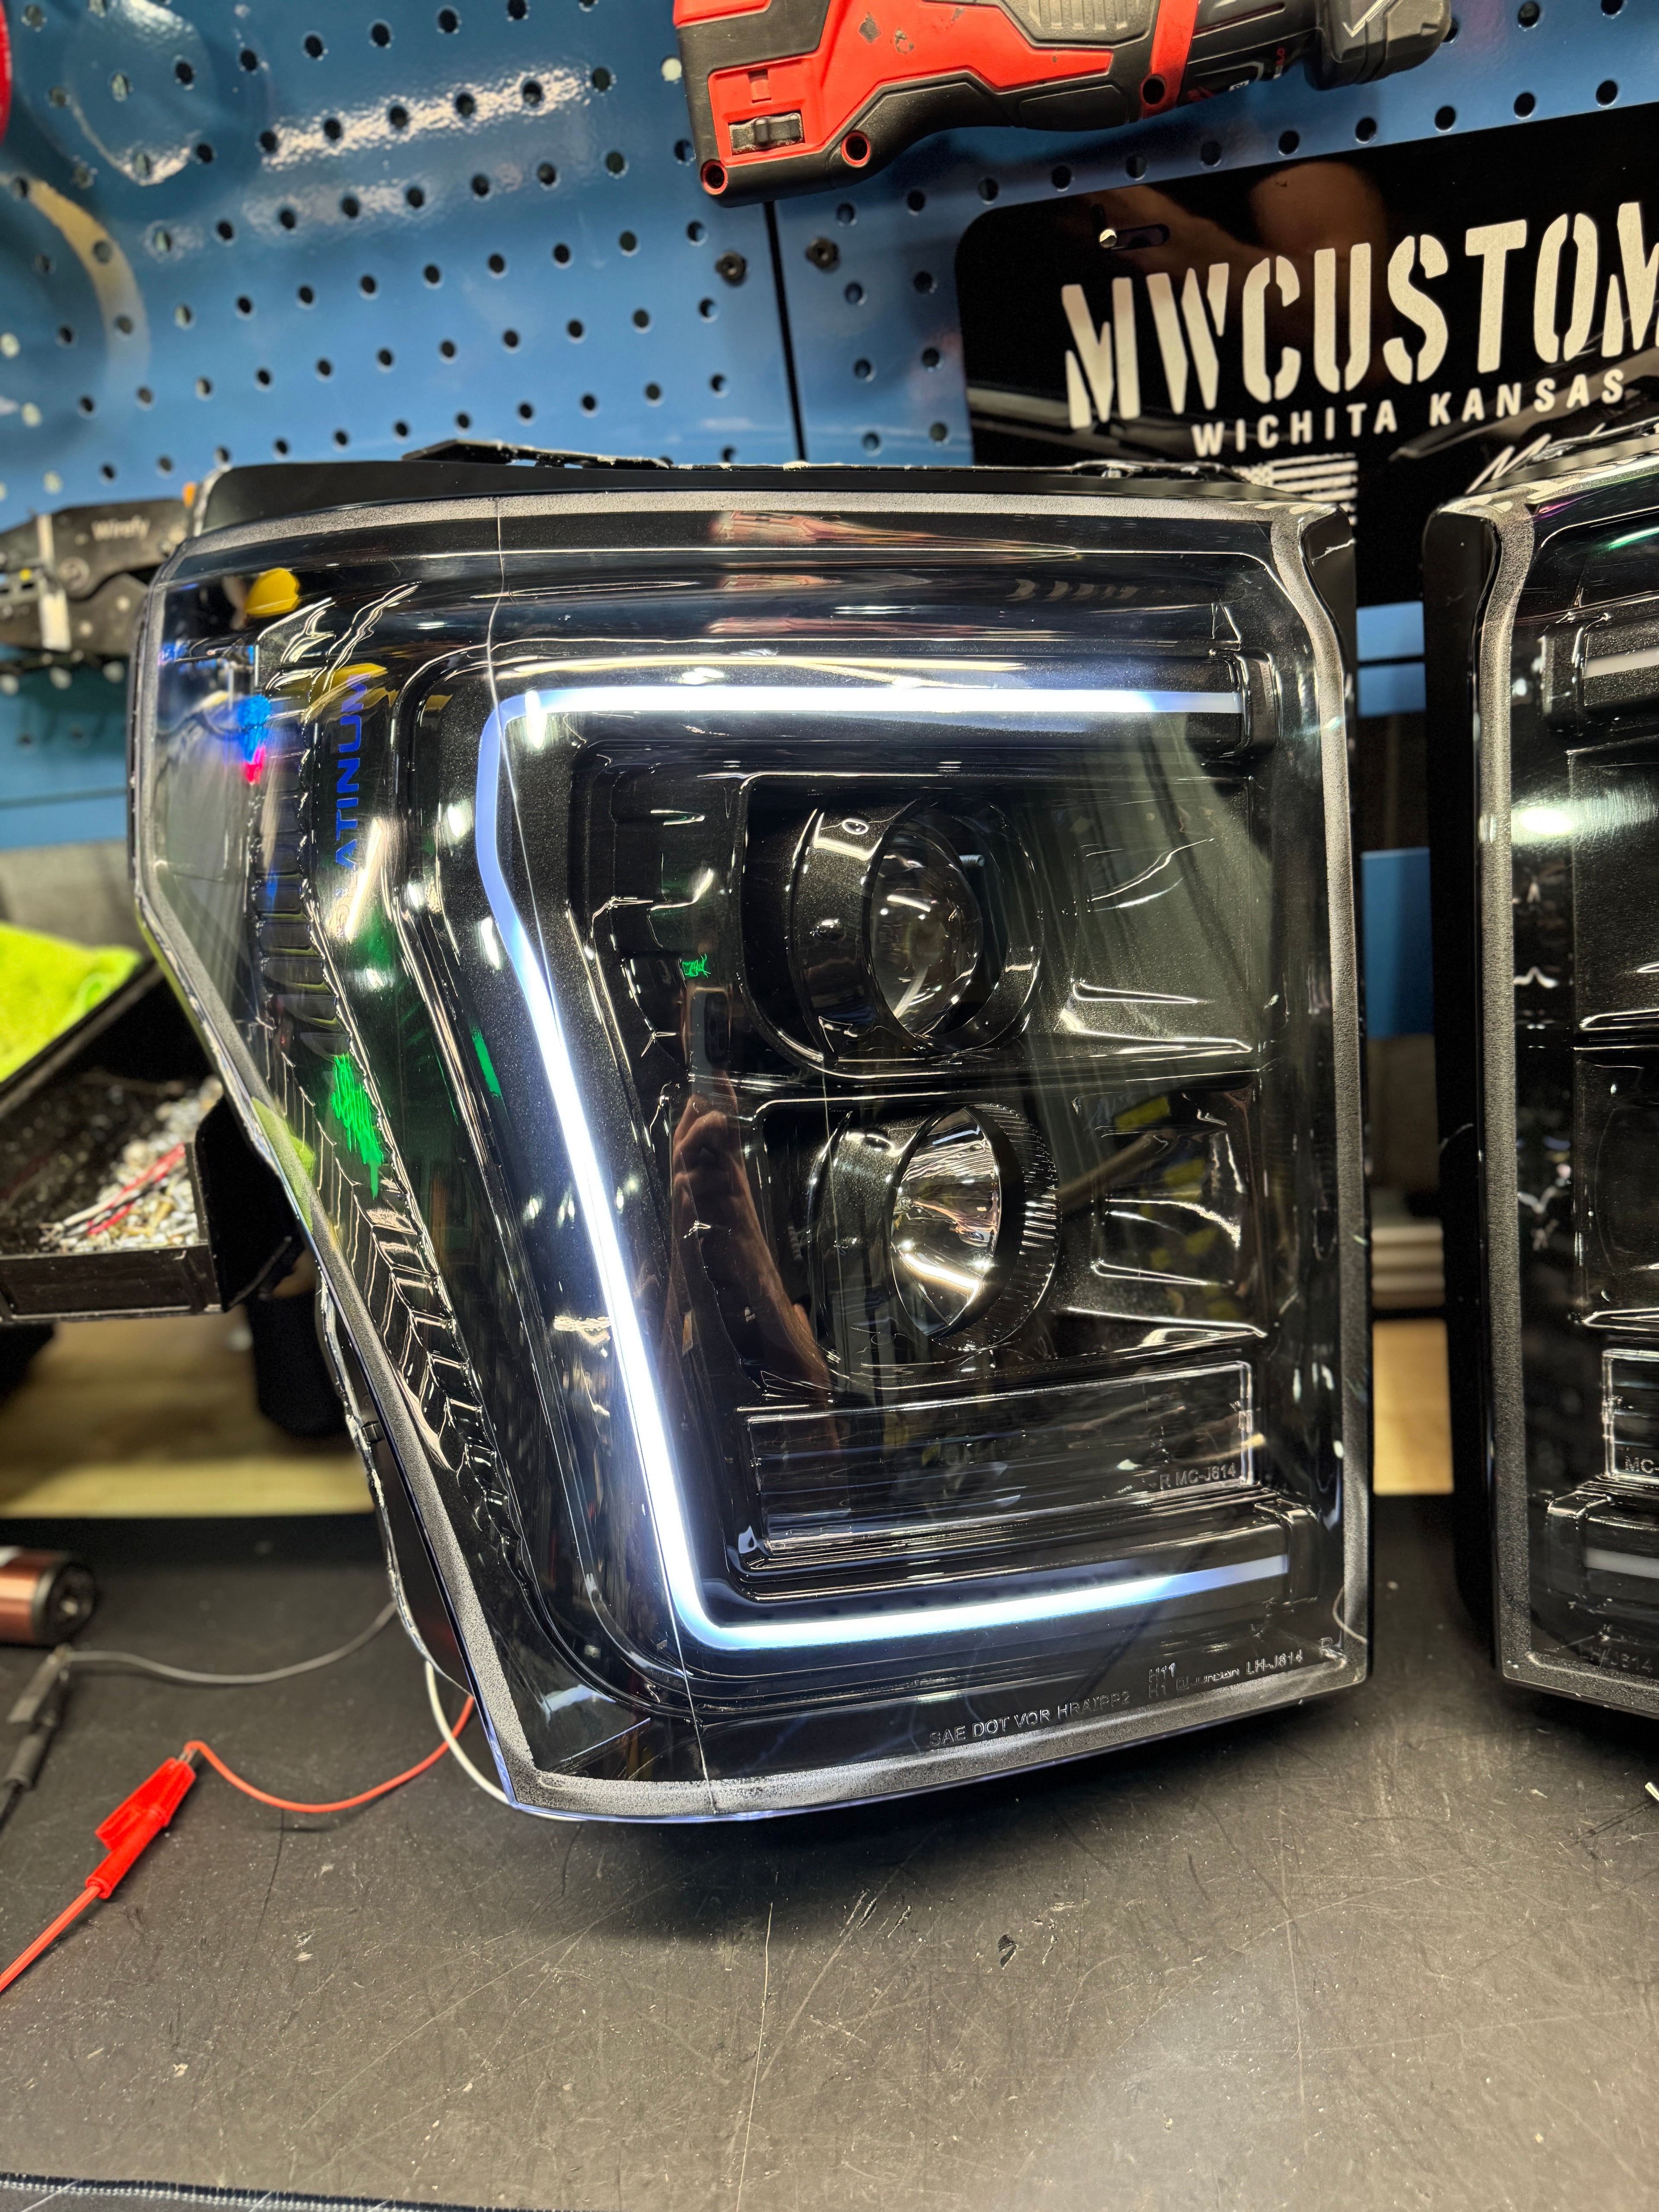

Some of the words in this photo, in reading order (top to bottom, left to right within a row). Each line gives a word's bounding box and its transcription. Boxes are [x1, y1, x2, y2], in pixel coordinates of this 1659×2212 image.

[1191, 399, 1397, 457] WICHITA
[1428, 369, 1624, 425] KANSAS
[1160, 1474, 1171, 1490] R
[1176, 1462, 1236, 1486] MC-J614
[1149, 1662, 1176, 1683] H11
[1149, 1682, 1166, 1698] H1
[929, 1725, 966, 1746] SAE
[972, 1716, 1009, 1738] DOT
[1014, 1709, 1050, 1728] VOR
